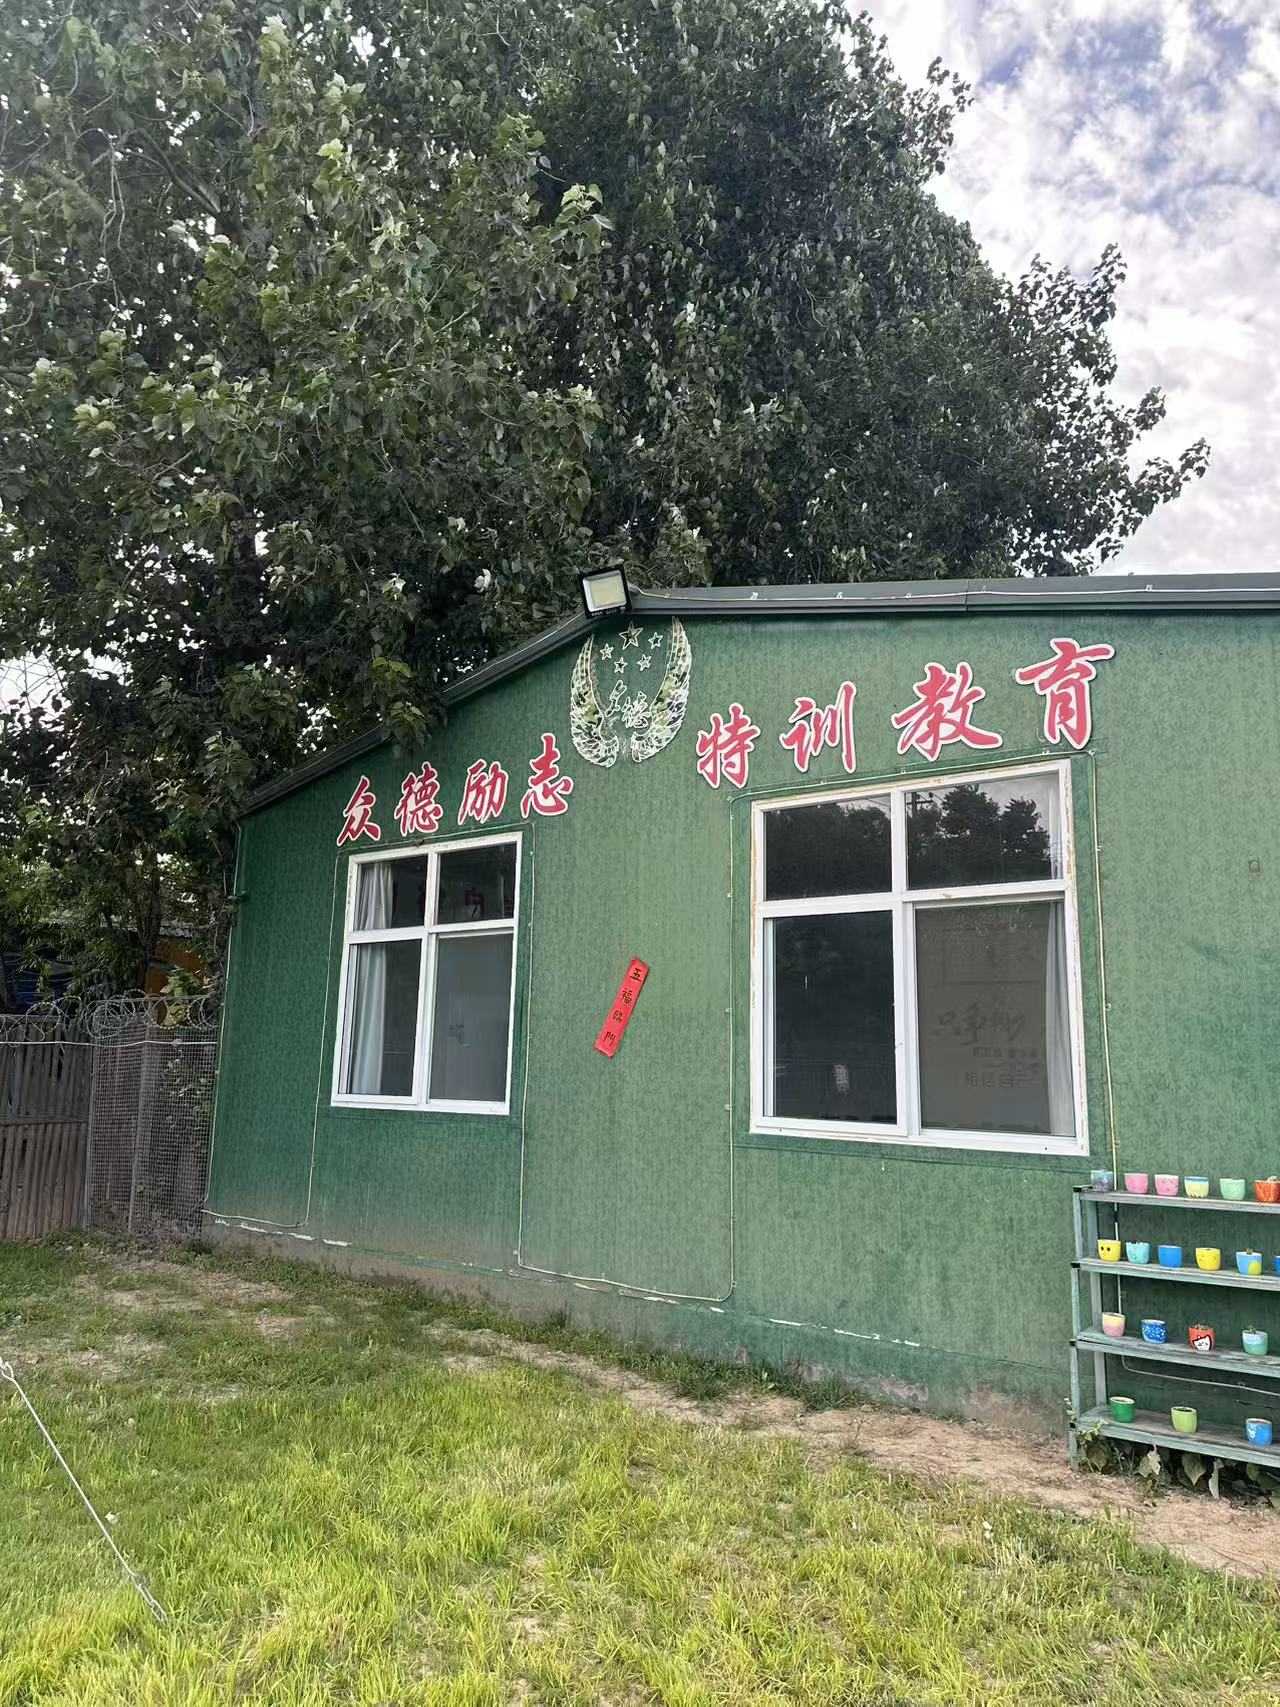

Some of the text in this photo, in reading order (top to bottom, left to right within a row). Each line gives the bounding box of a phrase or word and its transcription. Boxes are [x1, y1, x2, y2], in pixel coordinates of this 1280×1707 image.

[337, 638, 1115, 846] 众德励志 特训教育
